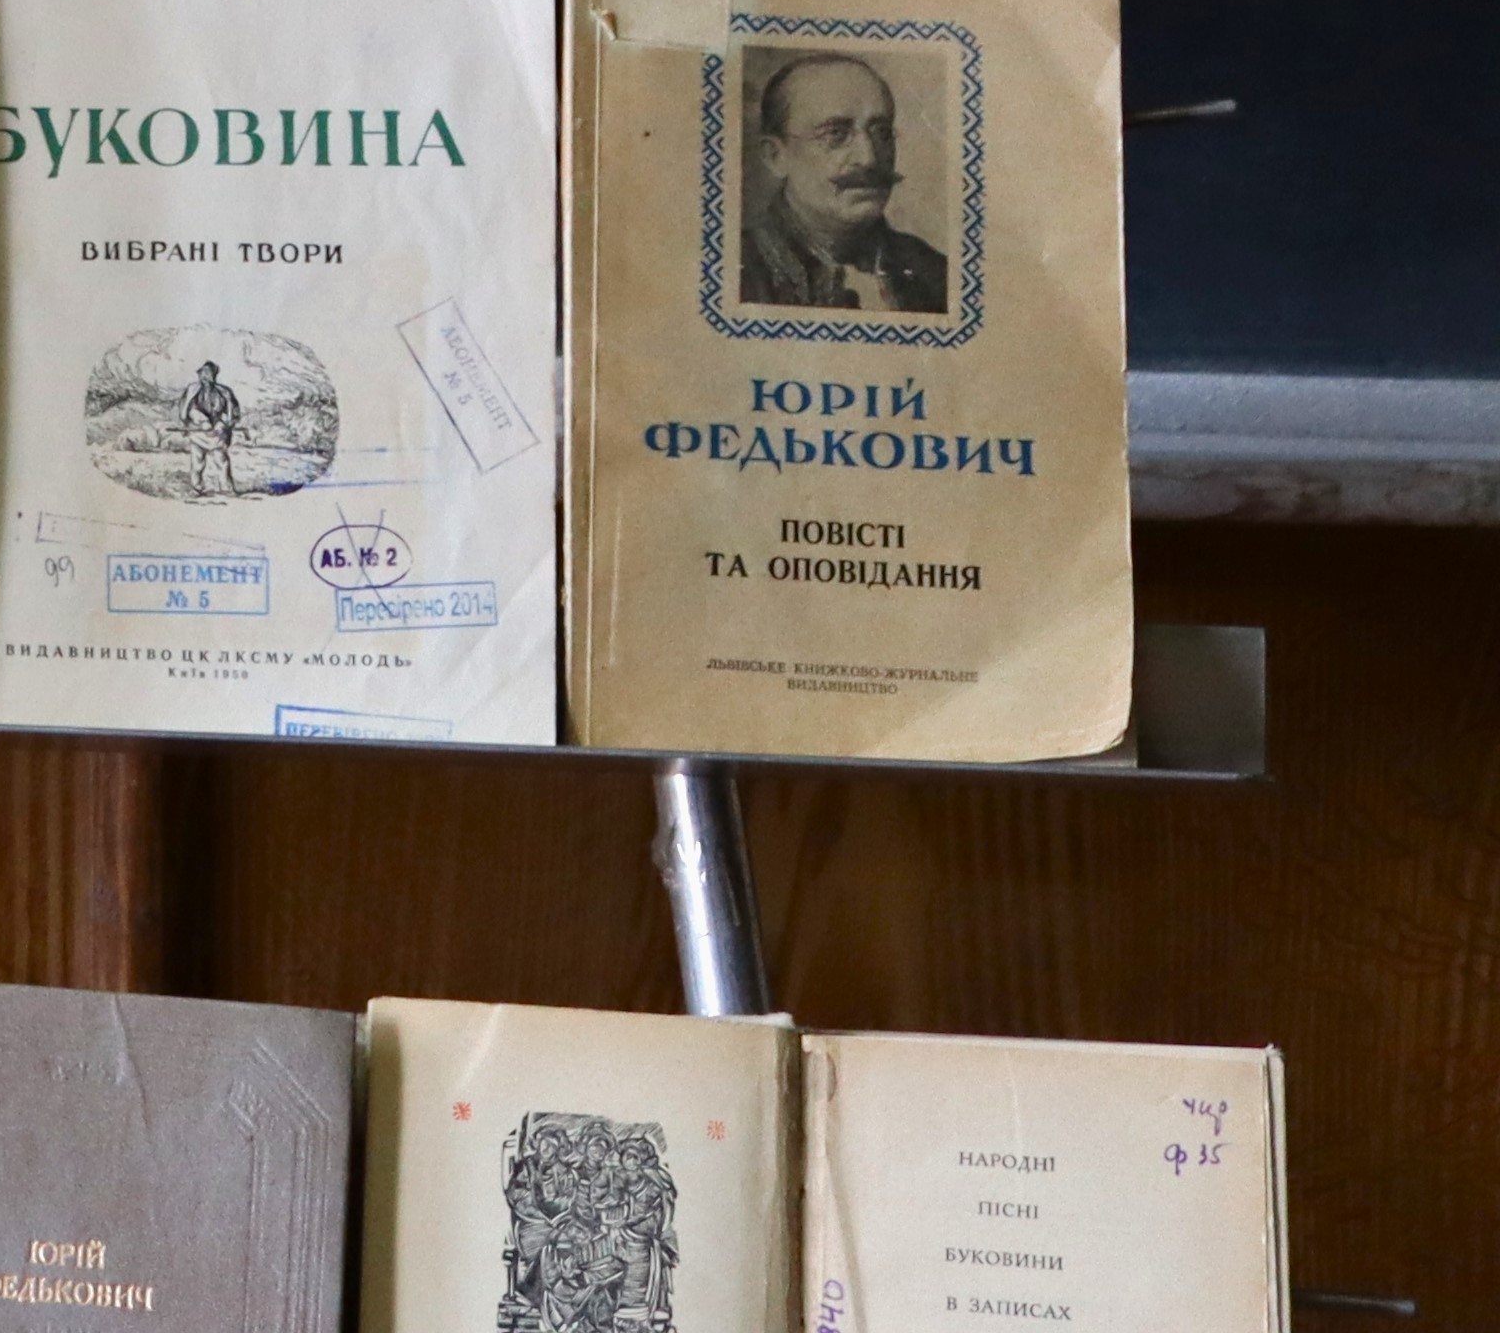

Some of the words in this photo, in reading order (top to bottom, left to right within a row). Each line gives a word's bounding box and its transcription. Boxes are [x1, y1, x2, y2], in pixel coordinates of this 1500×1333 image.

[81, 240, 220, 263] ВИБРАНІ
[238, 242, 344, 265] ТВОРИ
[751, 377, 928, 420] ЮРІЙ
[644, 422, 1037, 478] ФЕДЬКОВИЧ
[780, 519, 906, 550] ПОВІСТІ
[112, 565, 262, 584] АБОНЕМЕНТ
[704, 552, 748, 578] ТА
[768, 556, 982, 592] ОПОВІДАННЯ
[166, 591, 188, 607] №
[199, 591, 210, 608] 5
[340, 593, 444, 623] Перевірено
[5, 644, 173, 663] ВИДАВНИЦТВО
[182, 649, 209, 664] ЦК
[218, 649, 294, 664] ЛКСМУ
[303, 652, 412, 668] «МОЛОДЬ»
[706, 658, 785, 673] ЛЬВІВСЬКЕ
[794, 663, 978, 683] КНИЖКОВО-ЖУРНАЛЬНЕ
[787, 679, 898, 694] ВИДАВНИЦТВО
[959, 1150, 1055, 1173] НАРОДНІ
[979, 1201, 1039, 1219] ПІСНІ
[30, 1239, 106, 1269] ЮРІЙ
[944, 1247, 1064, 1271] БУКОВИНИ
[947, 1296, 957, 1311] В
[969, 1298, 1071, 1321] ЗАПИСАХ
